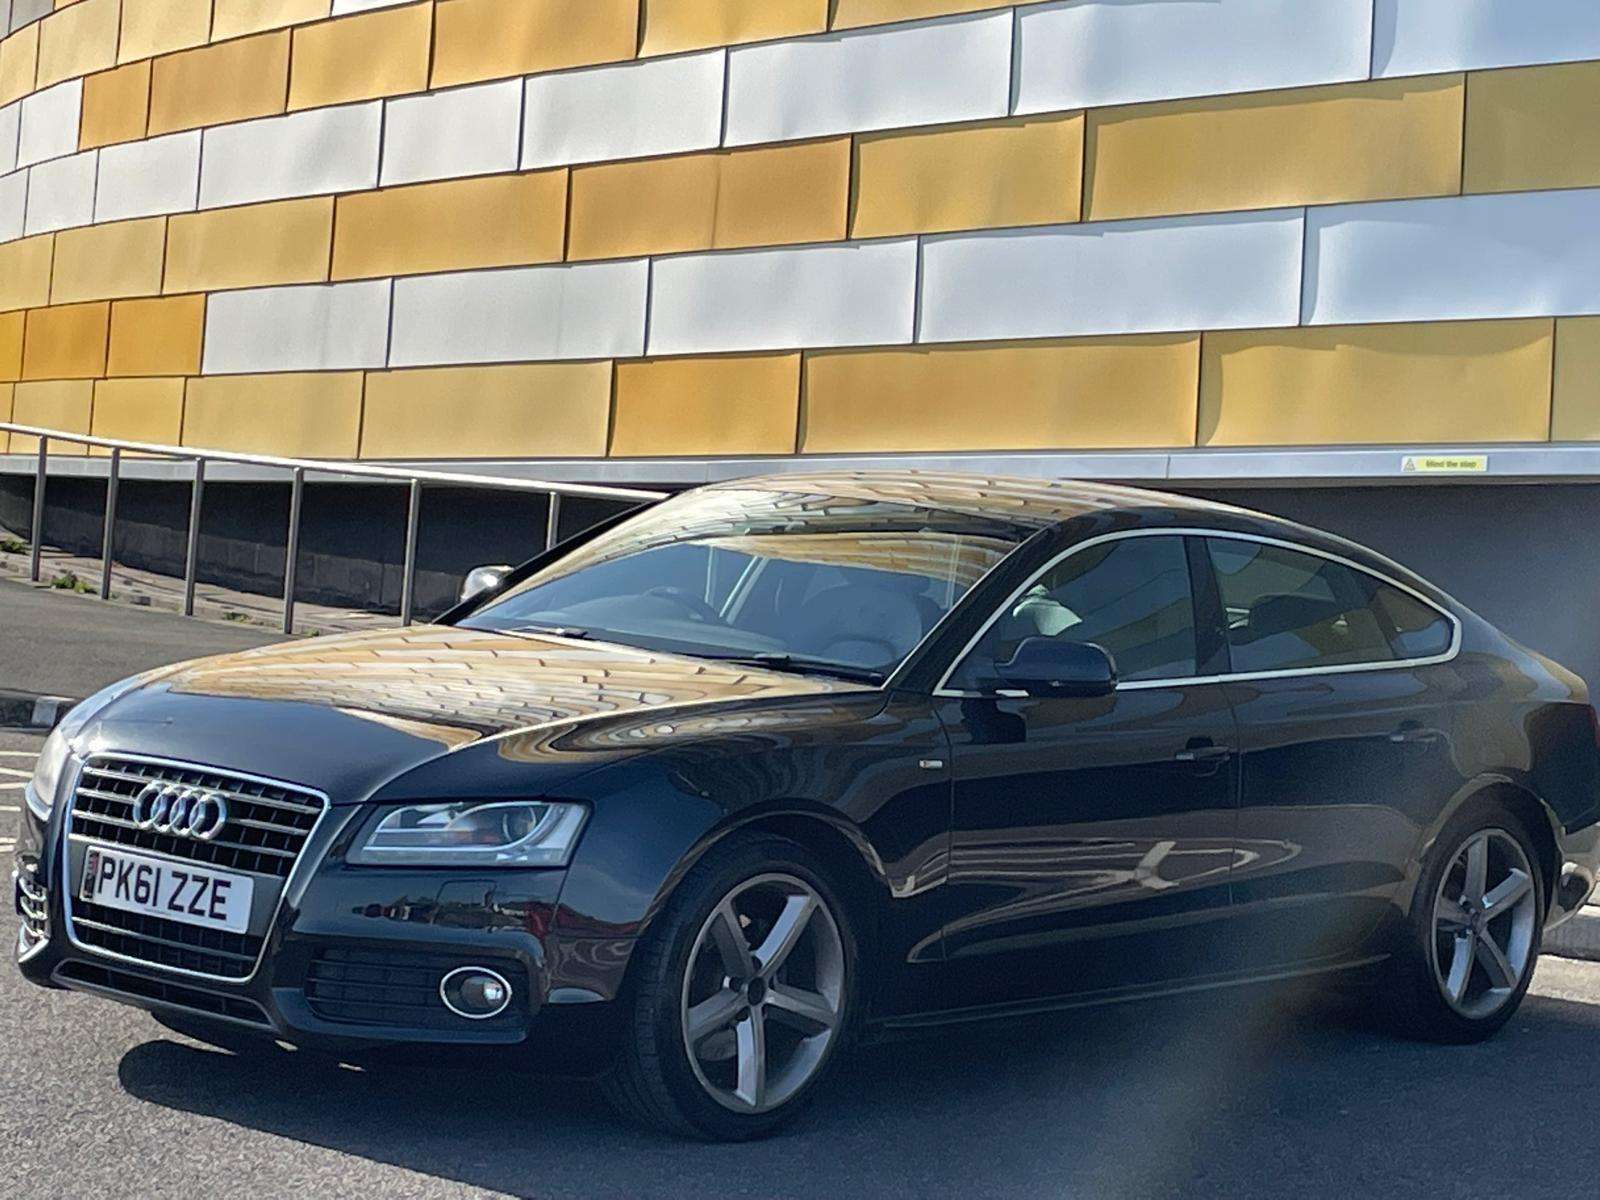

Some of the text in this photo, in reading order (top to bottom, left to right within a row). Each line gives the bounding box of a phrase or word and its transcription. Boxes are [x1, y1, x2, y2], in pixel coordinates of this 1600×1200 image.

[1446, 460, 1458, 468] the
[98, 856, 231, 921] PK61 ZZE
